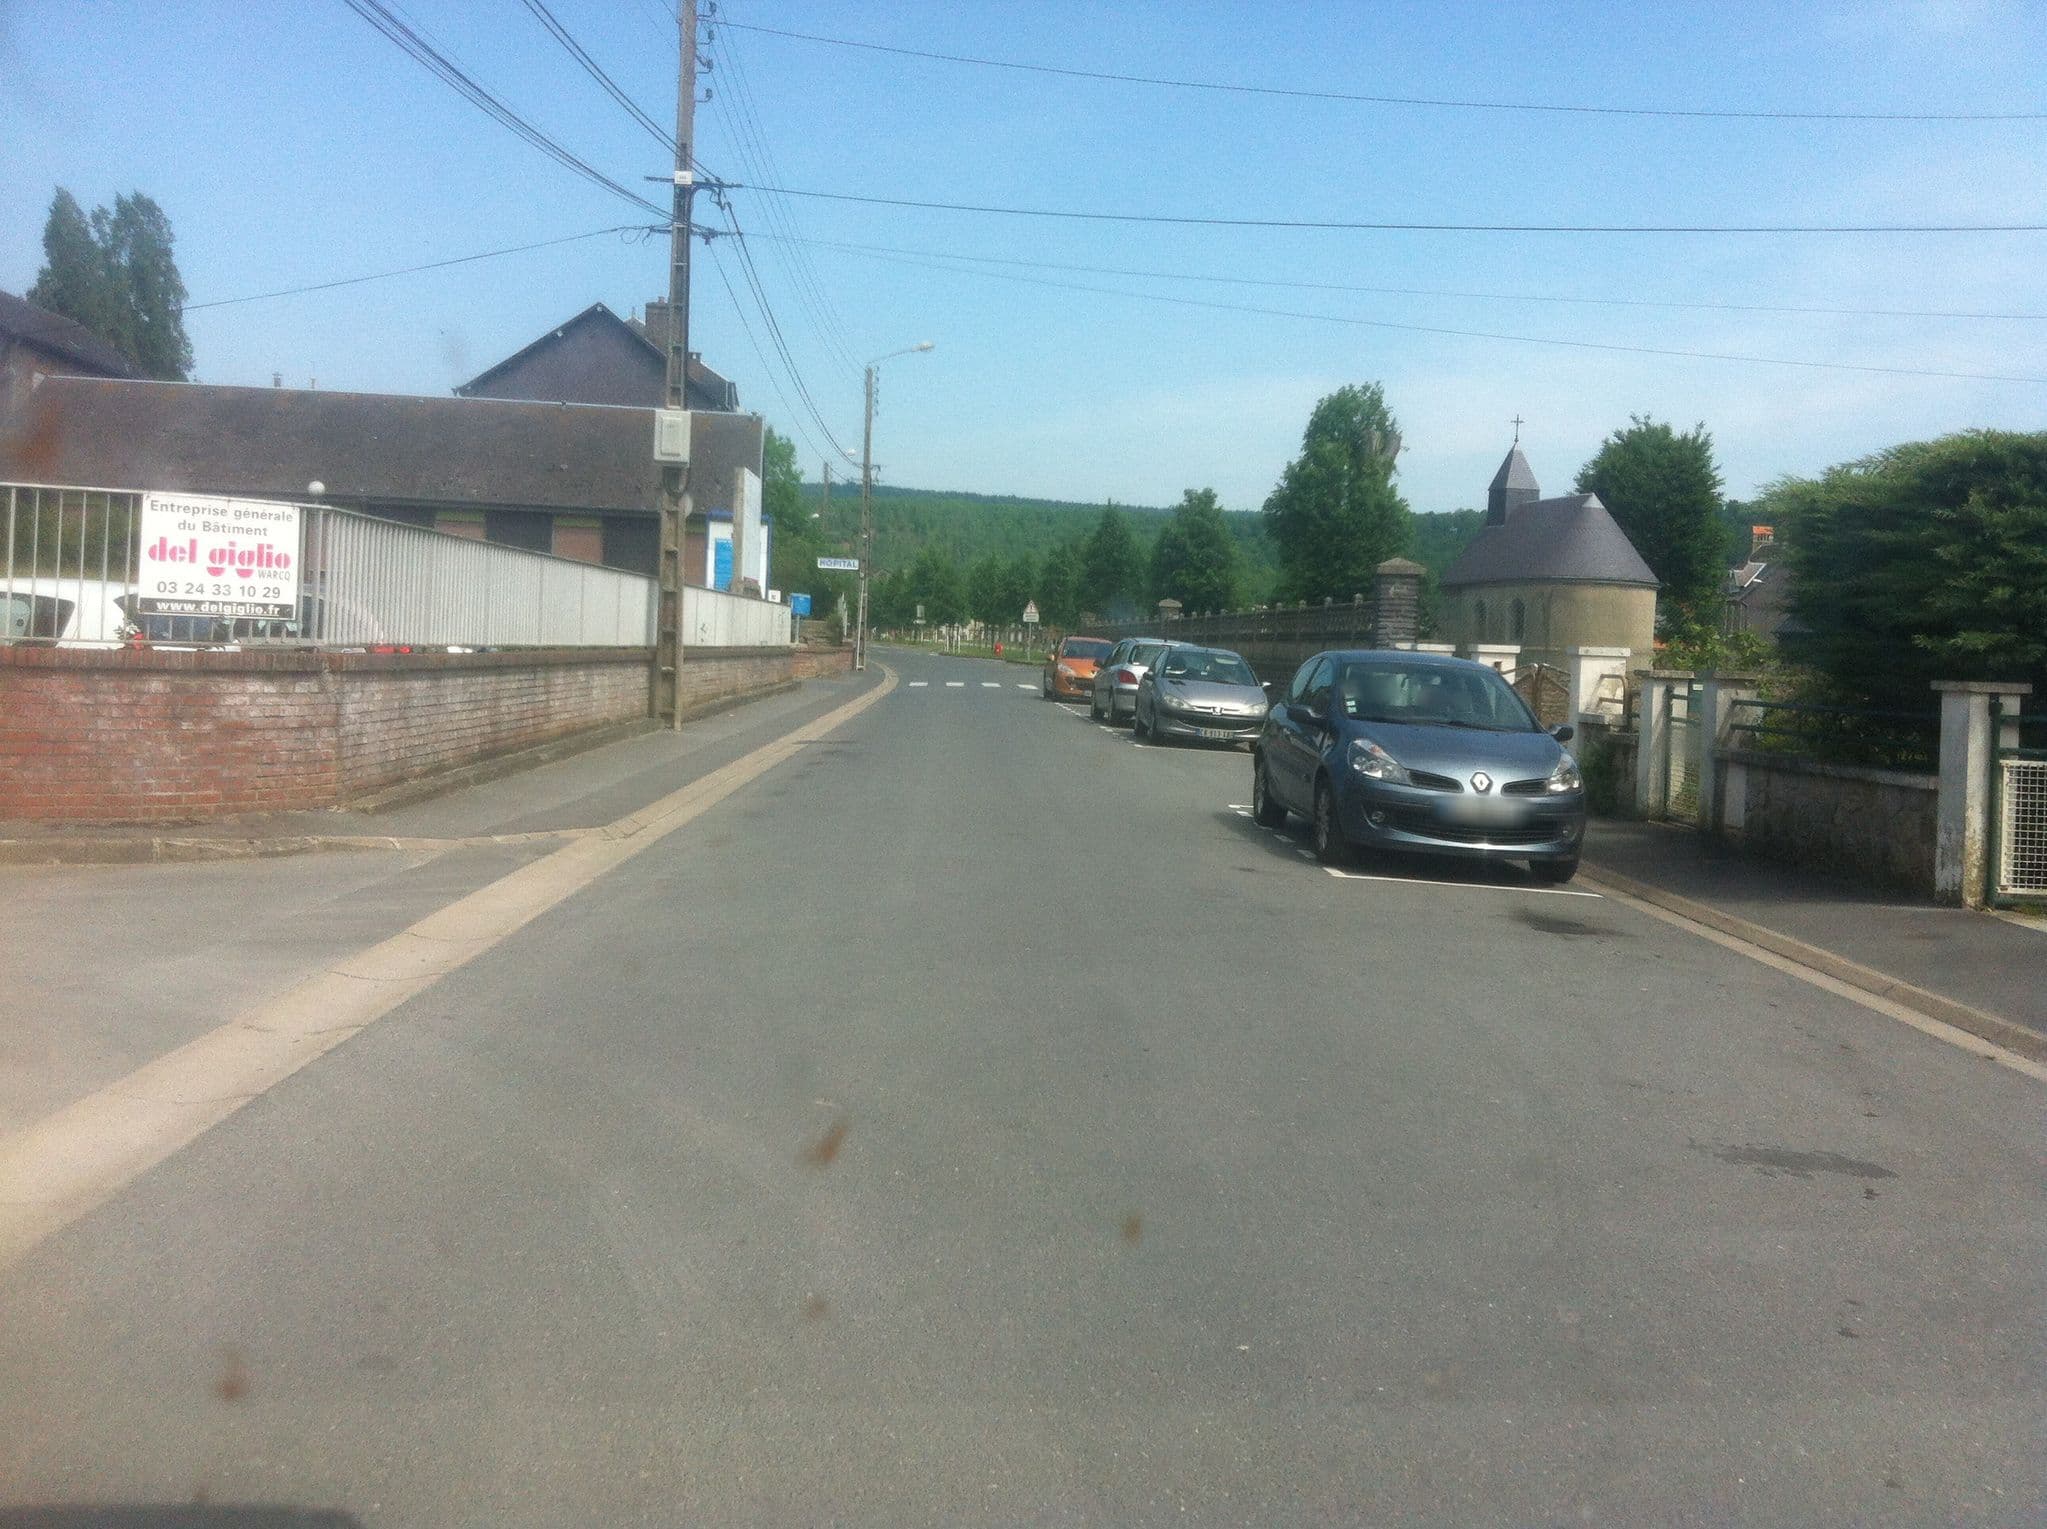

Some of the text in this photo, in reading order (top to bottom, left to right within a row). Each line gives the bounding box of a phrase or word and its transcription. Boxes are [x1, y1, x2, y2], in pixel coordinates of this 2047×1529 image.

[150, 501, 293, 522] Entreprise générale
[178, 519, 268, 536] du Bâtiment
[148, 536, 291, 578] del giglio
[157, 581, 281, 599] 03 24 33 10 29
[156, 601, 281, 616] www.delgiglio.fr
